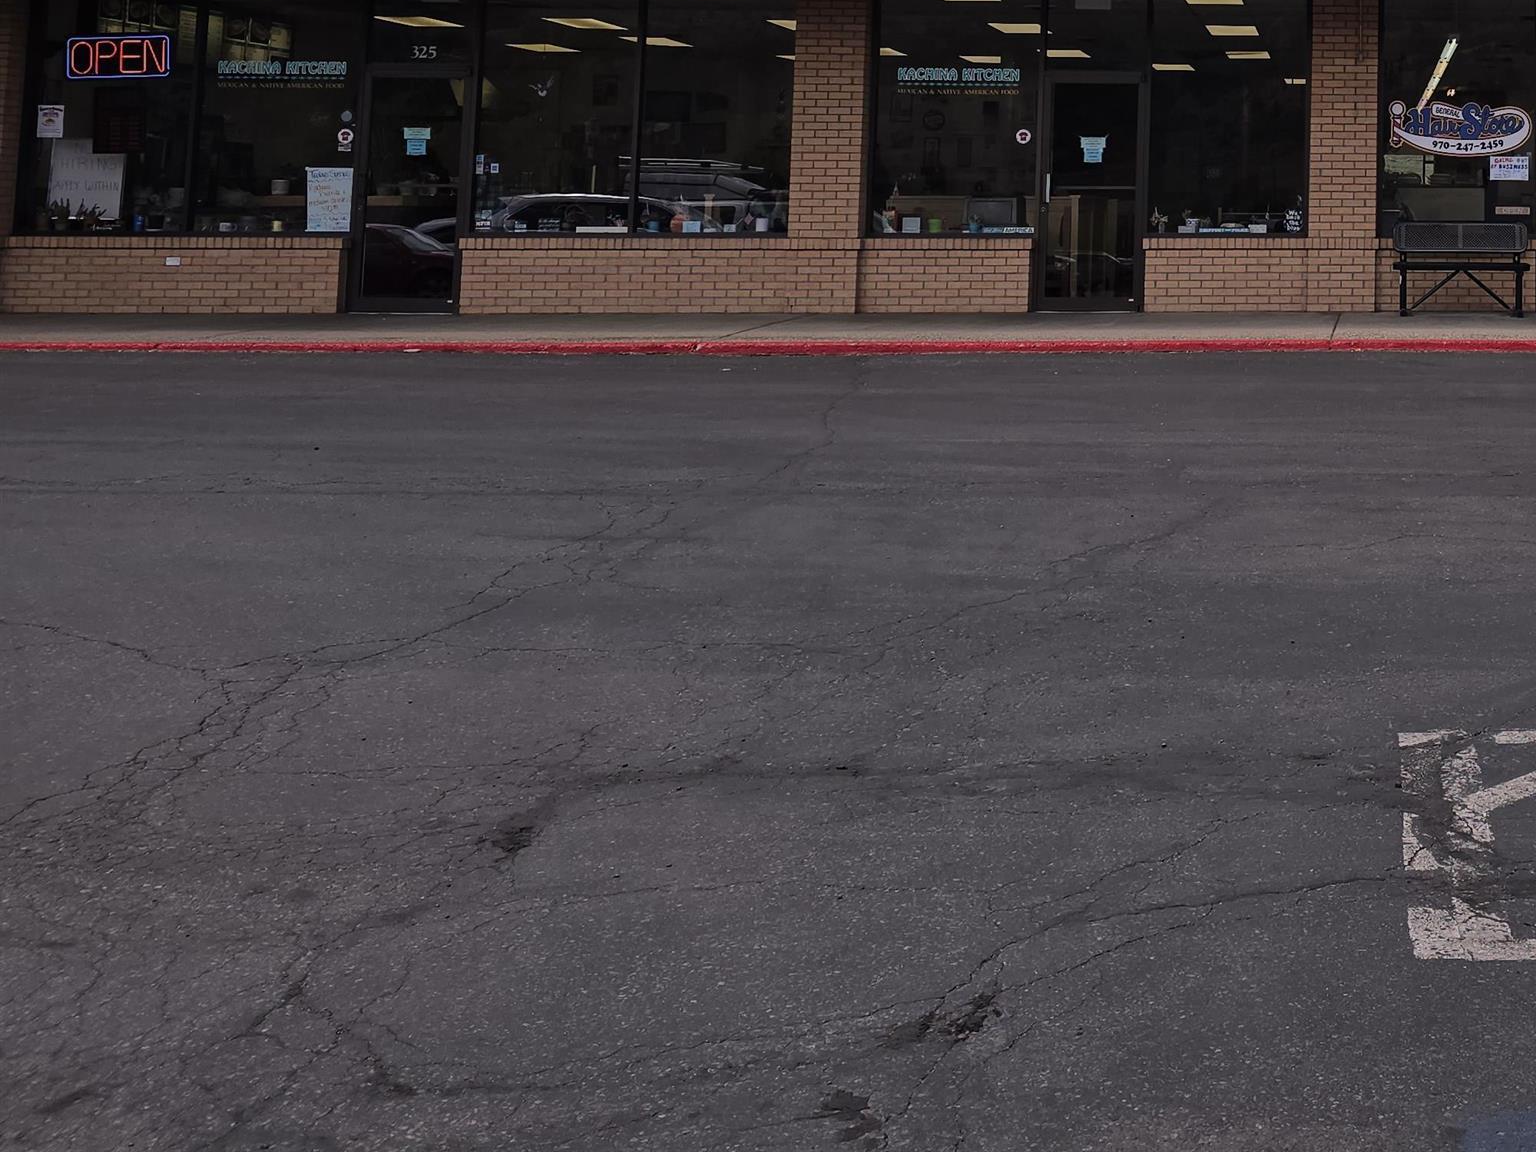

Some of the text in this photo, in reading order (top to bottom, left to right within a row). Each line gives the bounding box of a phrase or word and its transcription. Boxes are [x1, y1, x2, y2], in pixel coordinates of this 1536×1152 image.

[71, 40, 166, 74] OPEN
[411, 46, 437, 58] 325
[218, 60, 347, 75] KACHINA KITCHEN
[898, 67, 1020, 82] KACHINA KITCHEN
[1435, 107, 1460, 118] GENERAL
[1404, 107, 1460, 136] Hair
[1432, 140, 1504, 152] 970-247-2459
